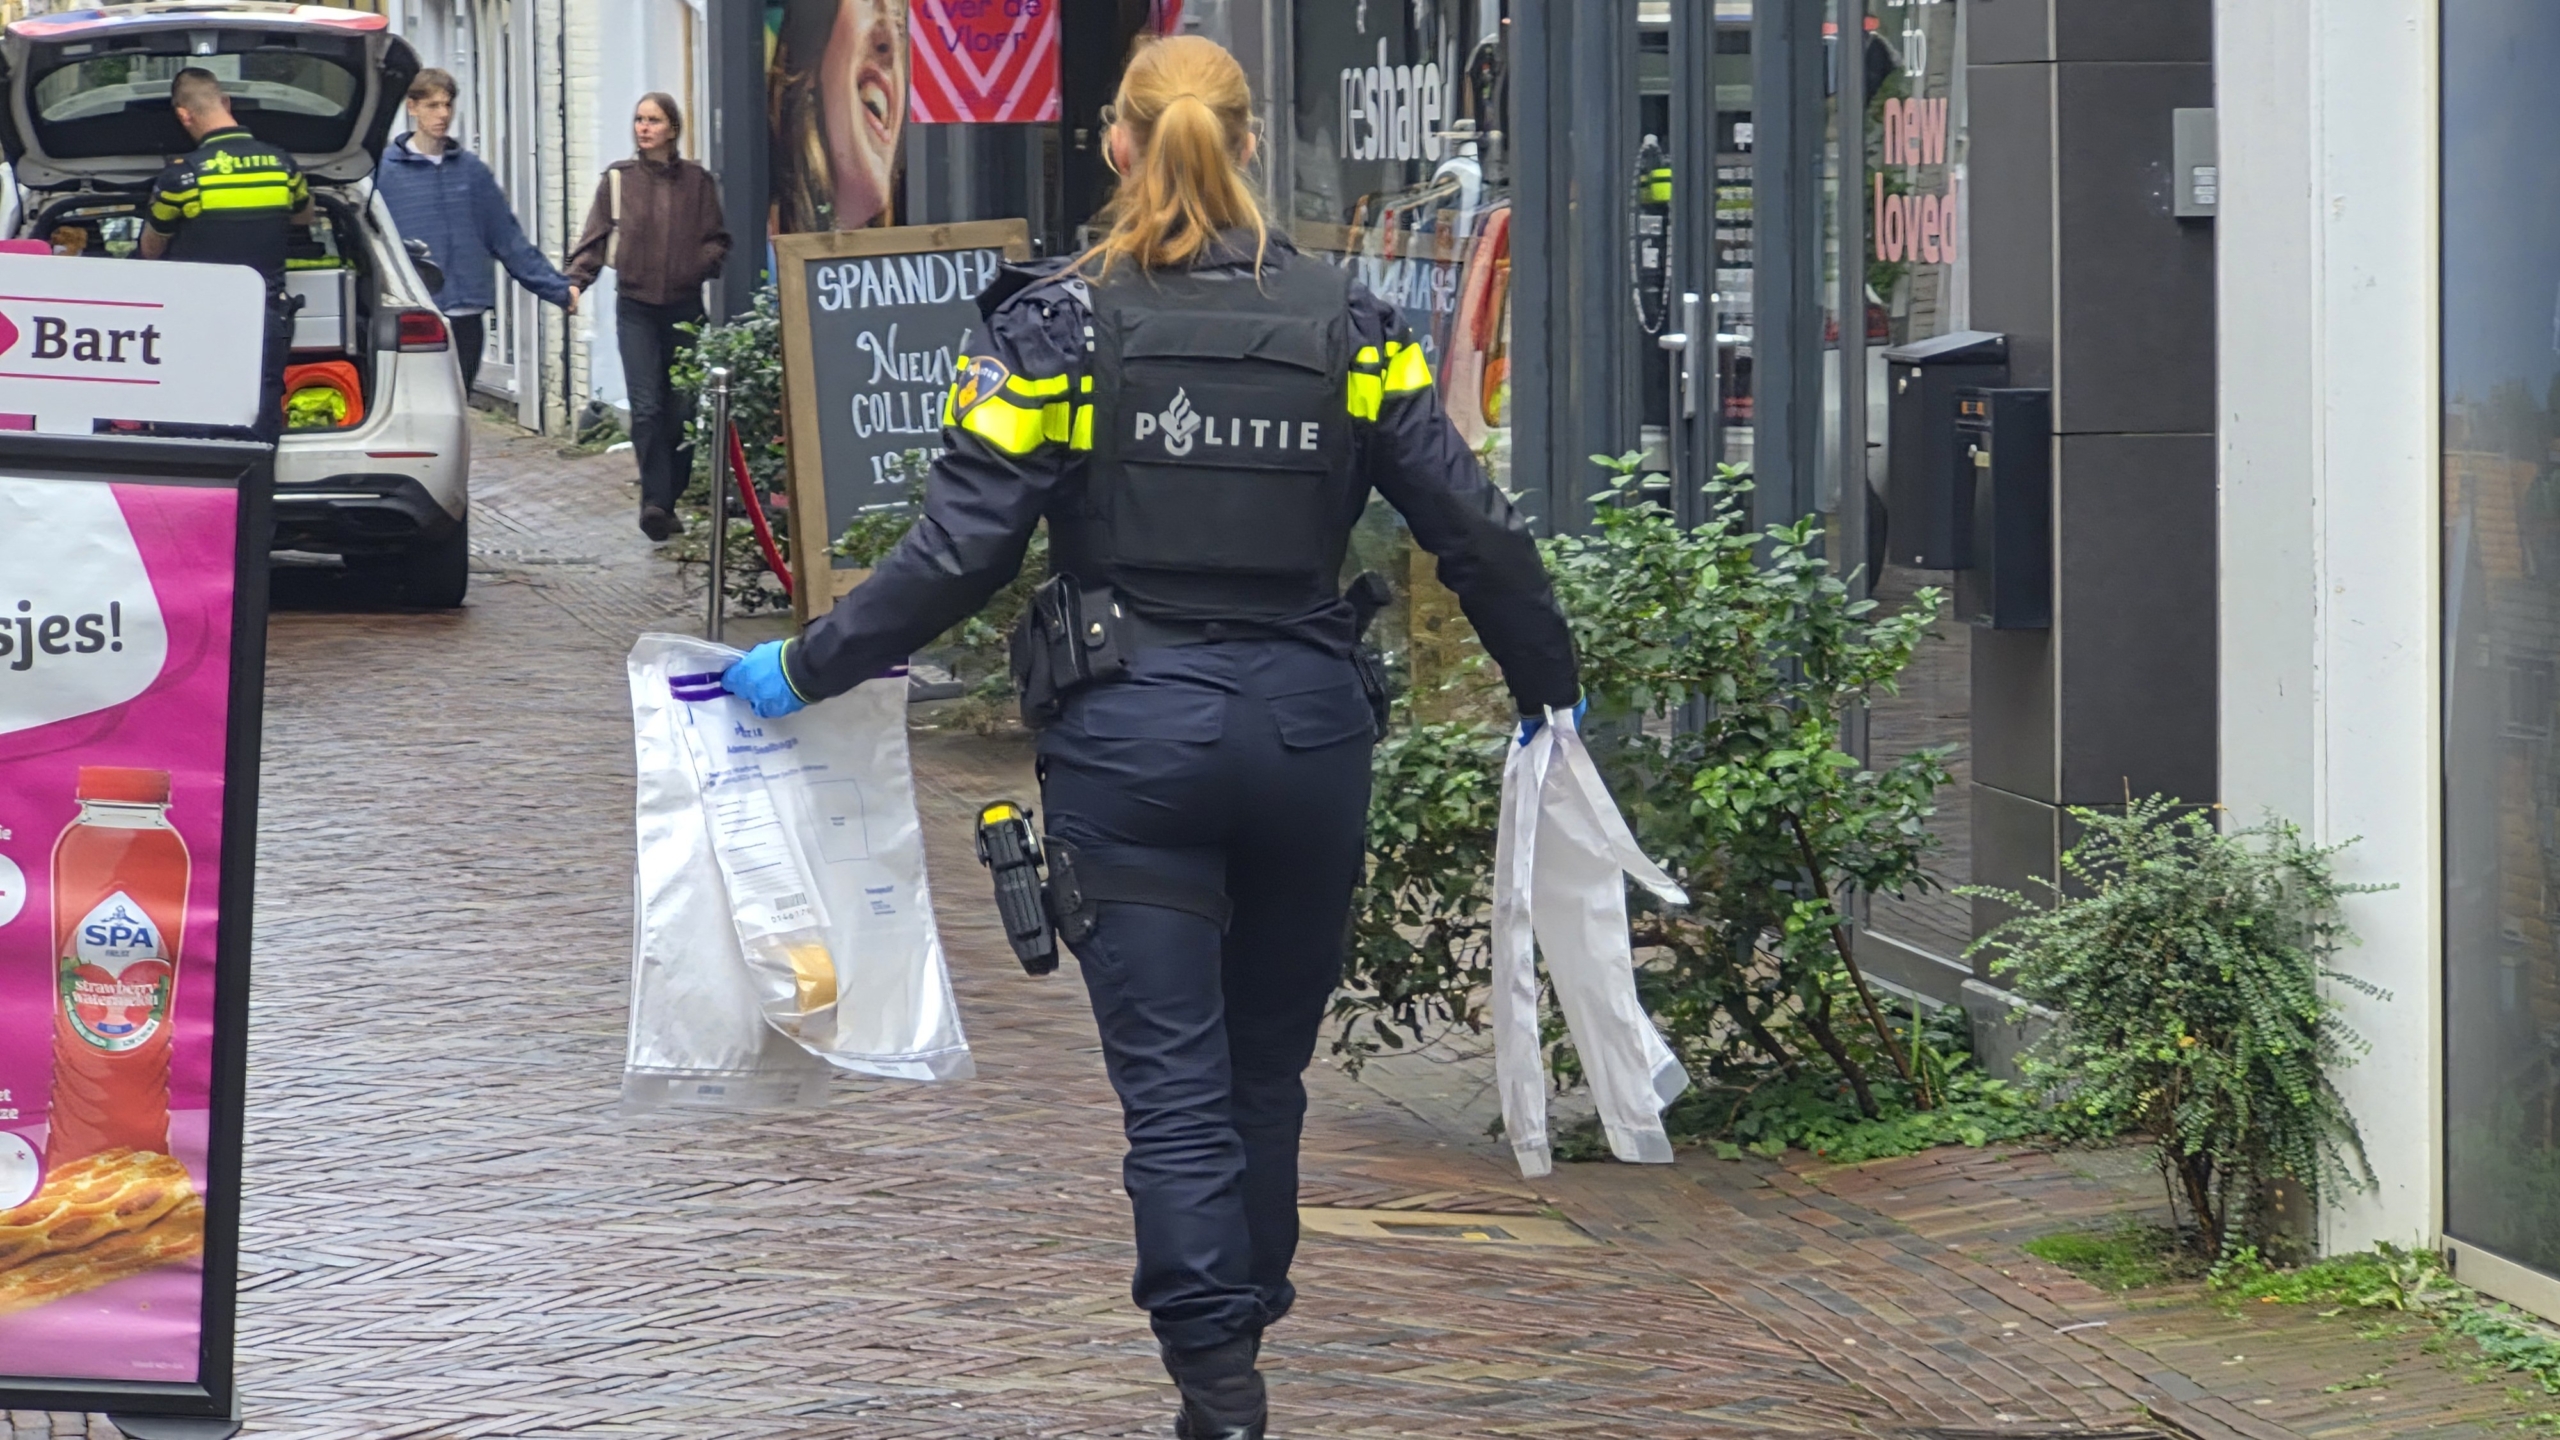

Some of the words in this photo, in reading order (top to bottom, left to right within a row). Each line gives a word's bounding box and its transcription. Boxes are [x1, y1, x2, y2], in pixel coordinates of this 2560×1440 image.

[938, 25, 1027, 53] Vloer
[1902, 18, 1926, 77] to
[1884, 97, 1947, 165] new
[1874, 172, 1957, 264] loved
[31, 316, 162, 365] Bart
[85, 925, 154, 948] SPA
